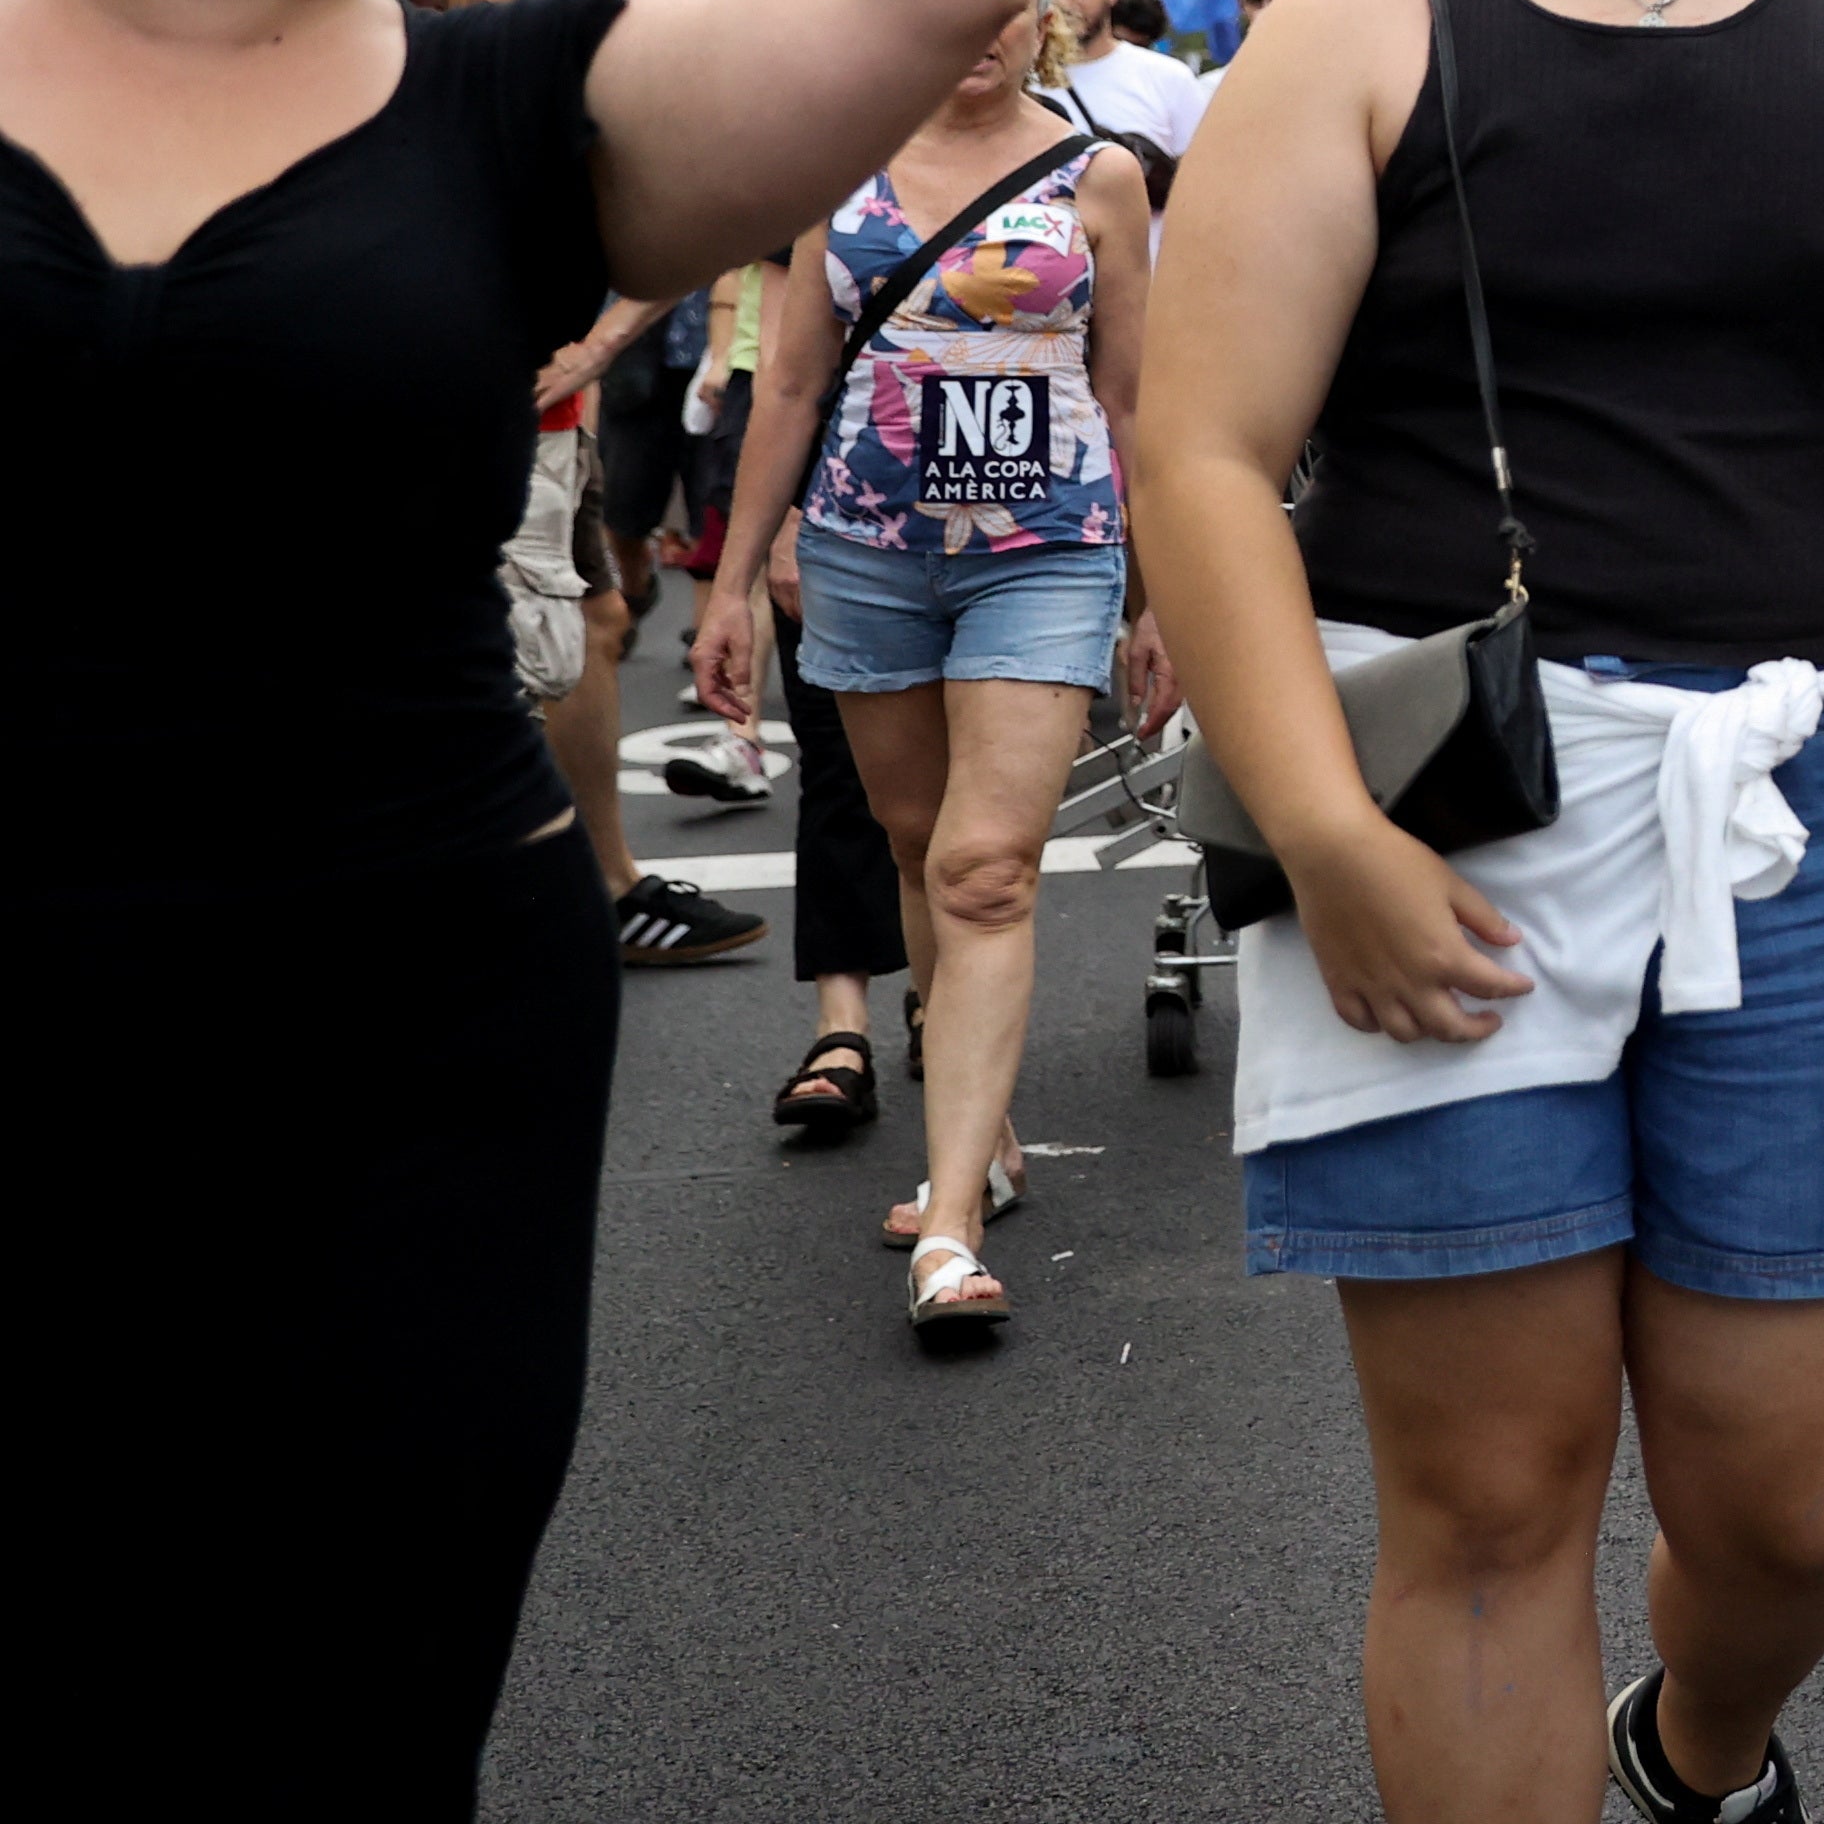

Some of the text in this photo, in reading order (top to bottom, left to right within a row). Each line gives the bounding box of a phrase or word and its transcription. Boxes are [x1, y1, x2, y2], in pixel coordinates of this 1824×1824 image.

[938, 379, 1033, 457] NO
[925, 460, 1045, 478] A LA COPA
[925, 479, 1046, 500] AMÈRICA
